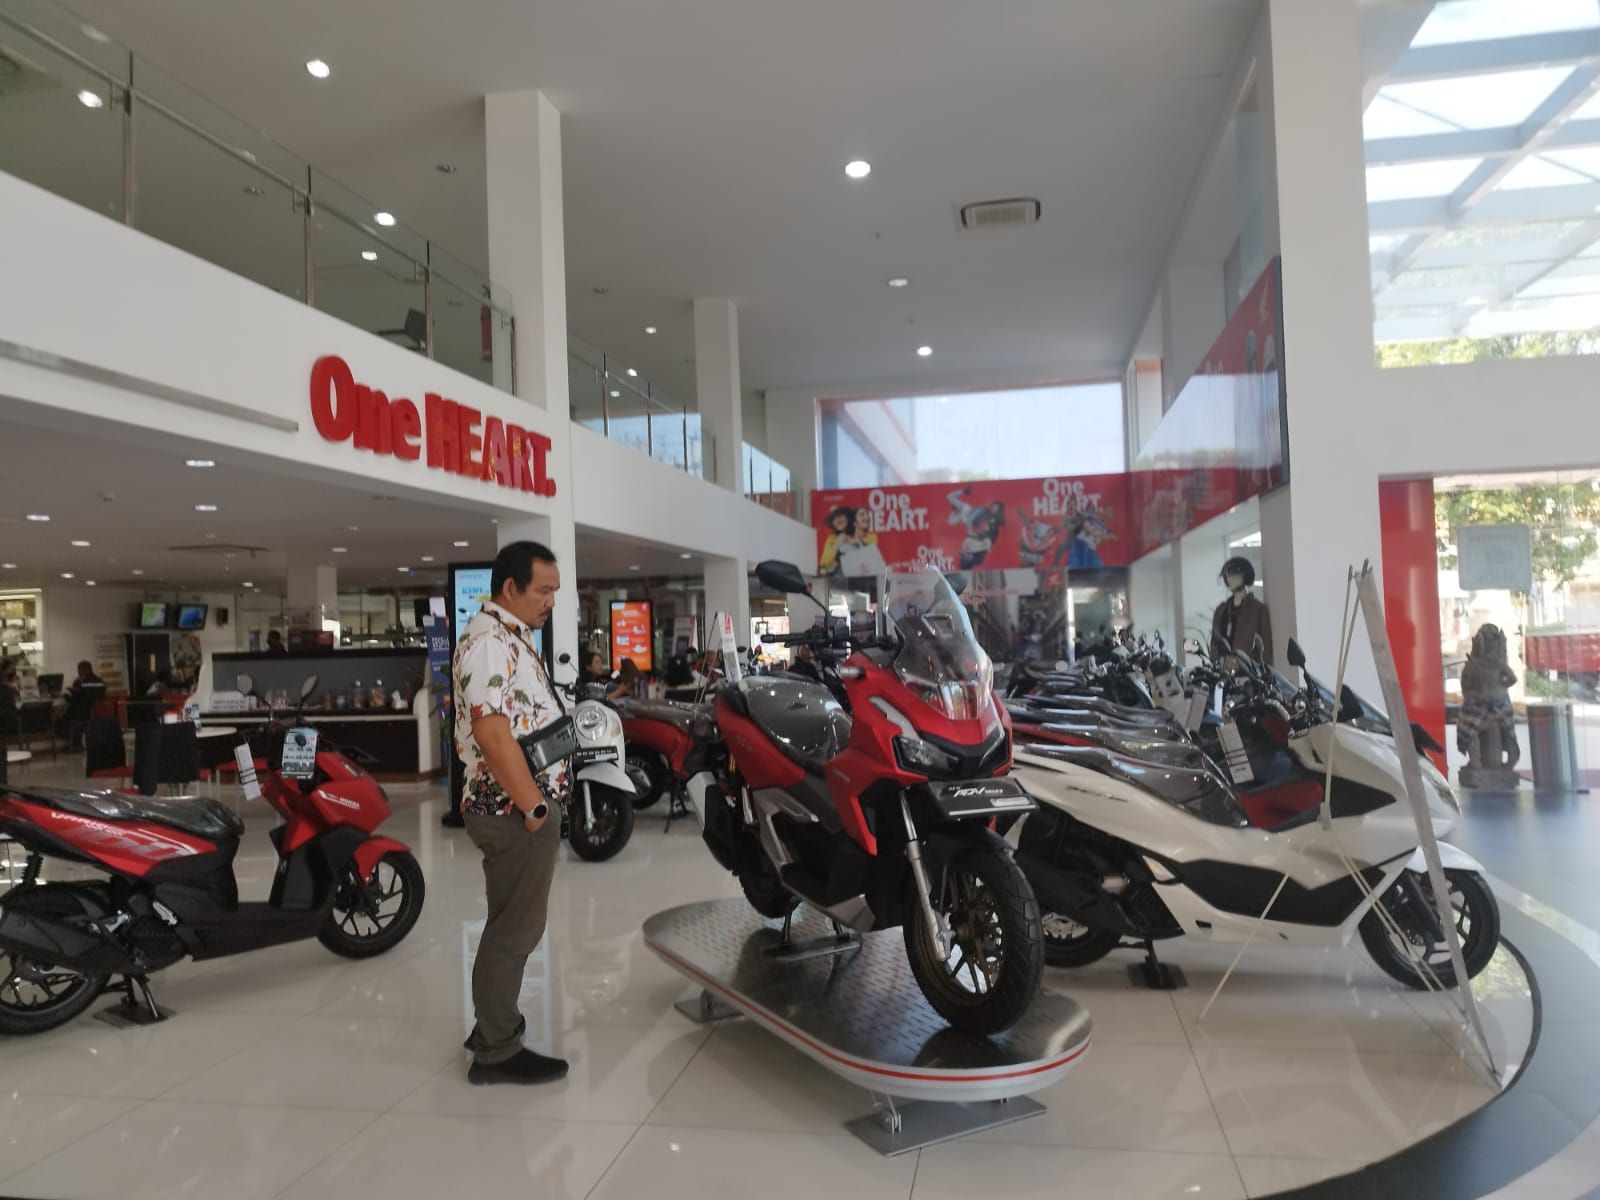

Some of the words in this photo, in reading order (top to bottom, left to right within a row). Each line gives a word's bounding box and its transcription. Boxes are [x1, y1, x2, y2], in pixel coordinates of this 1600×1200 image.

[310, 354, 421, 461] One
[425, 392, 556, 497] HEART.
[1043, 477, 1084, 497] One
[868, 489, 910, 511] One
